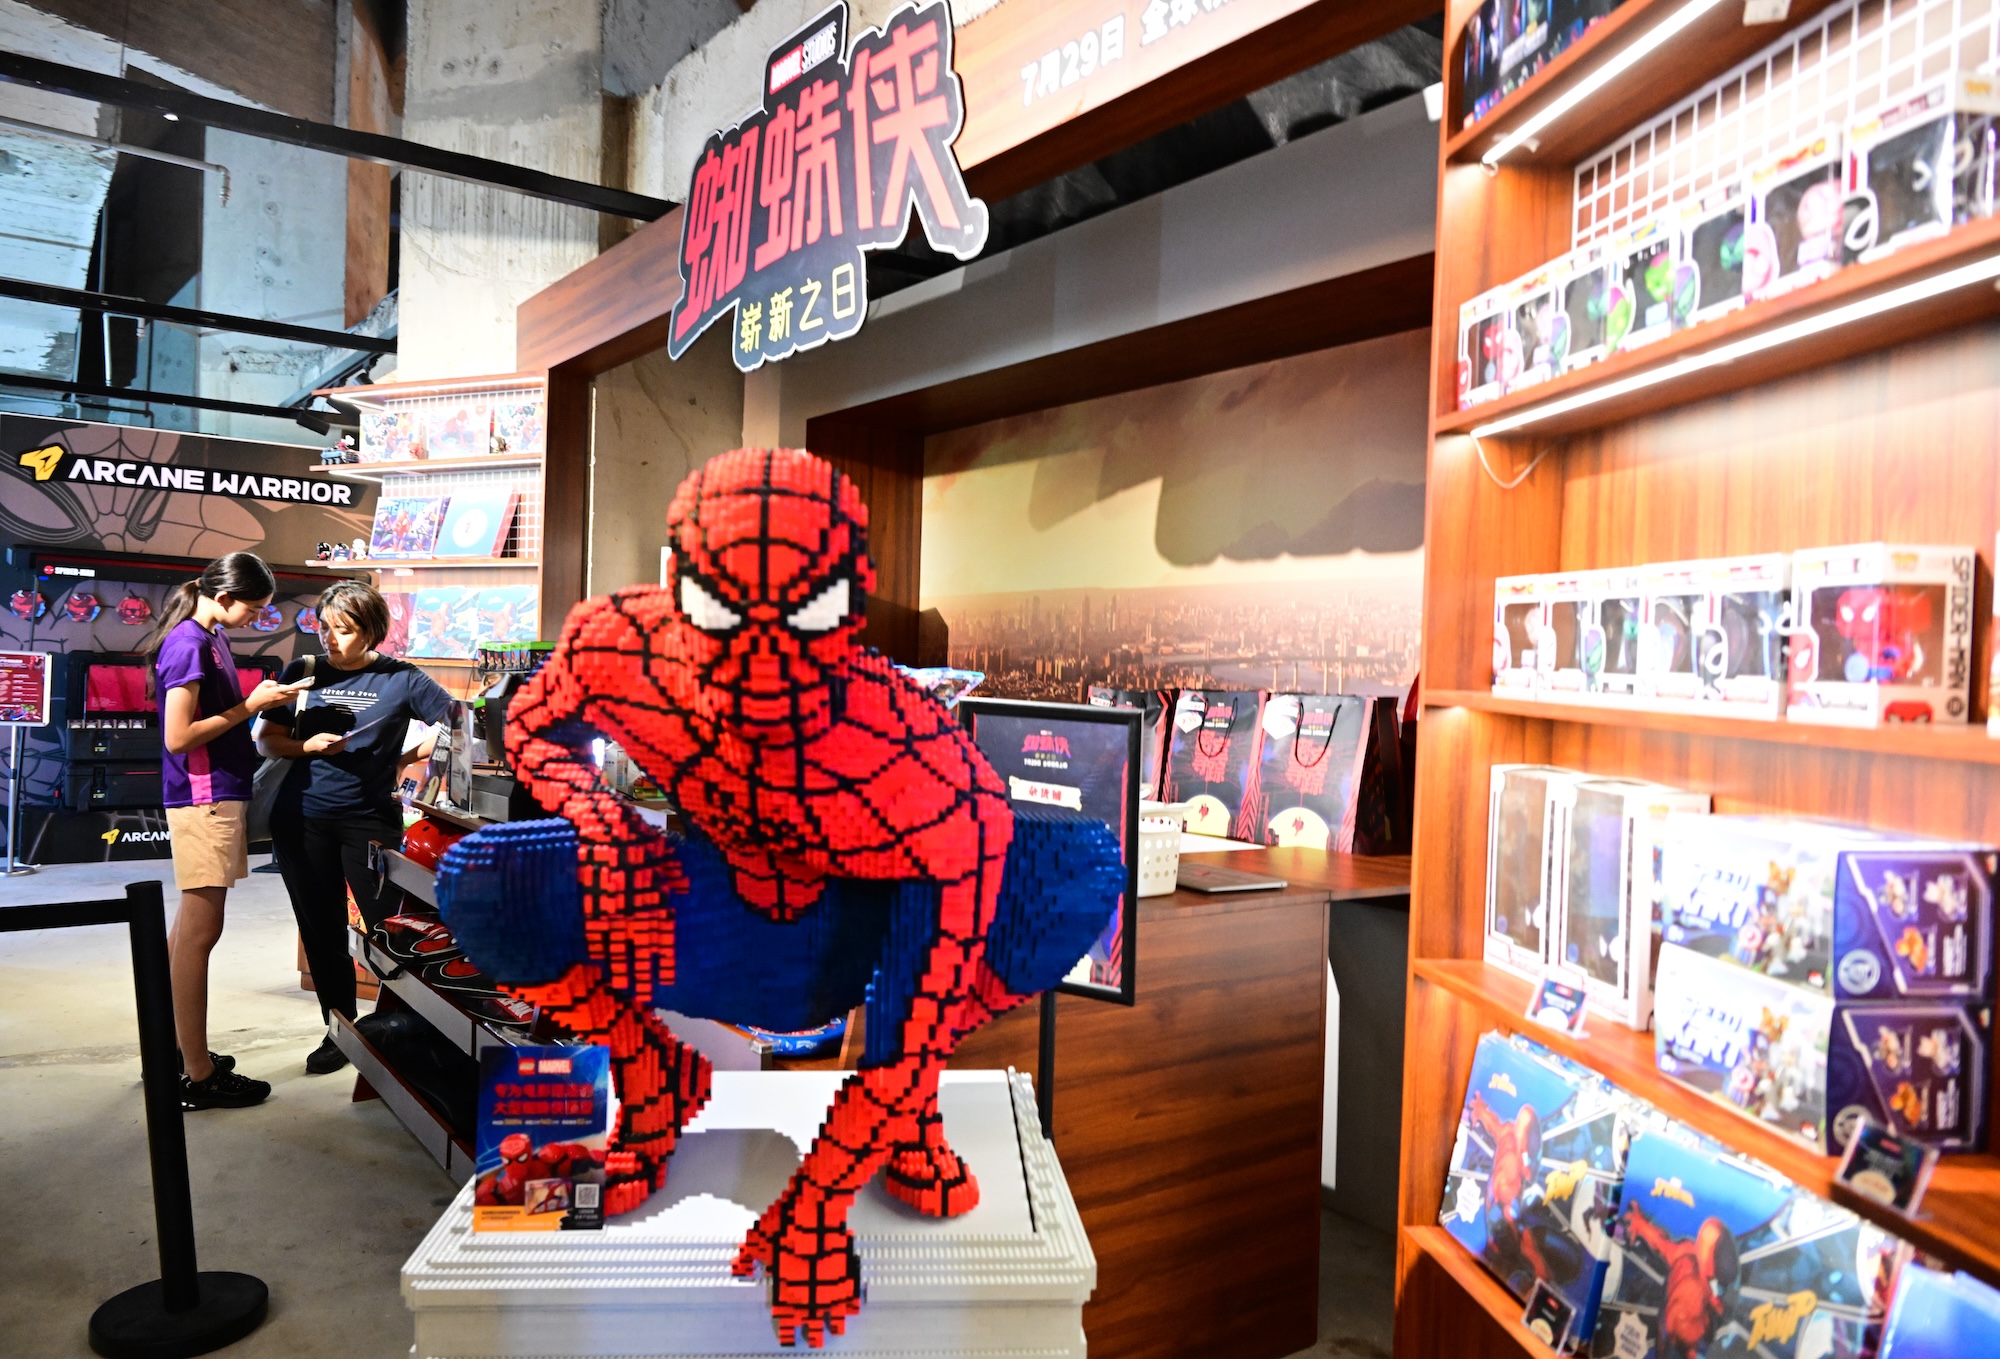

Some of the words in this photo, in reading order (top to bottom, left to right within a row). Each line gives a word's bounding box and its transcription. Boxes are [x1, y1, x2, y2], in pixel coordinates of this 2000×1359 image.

[1021, 14, 1125, 107] 7月29日
[674, 18, 961, 343] 蜘蛛侠
[740, 262, 857, 354] 崭新之日
[68, 458, 205, 491] ARCANE
[212, 472, 352, 504] WARRIOR
[121, 831, 170, 842] ARCAN
[538, 1059, 572, 1074] MARVEL
